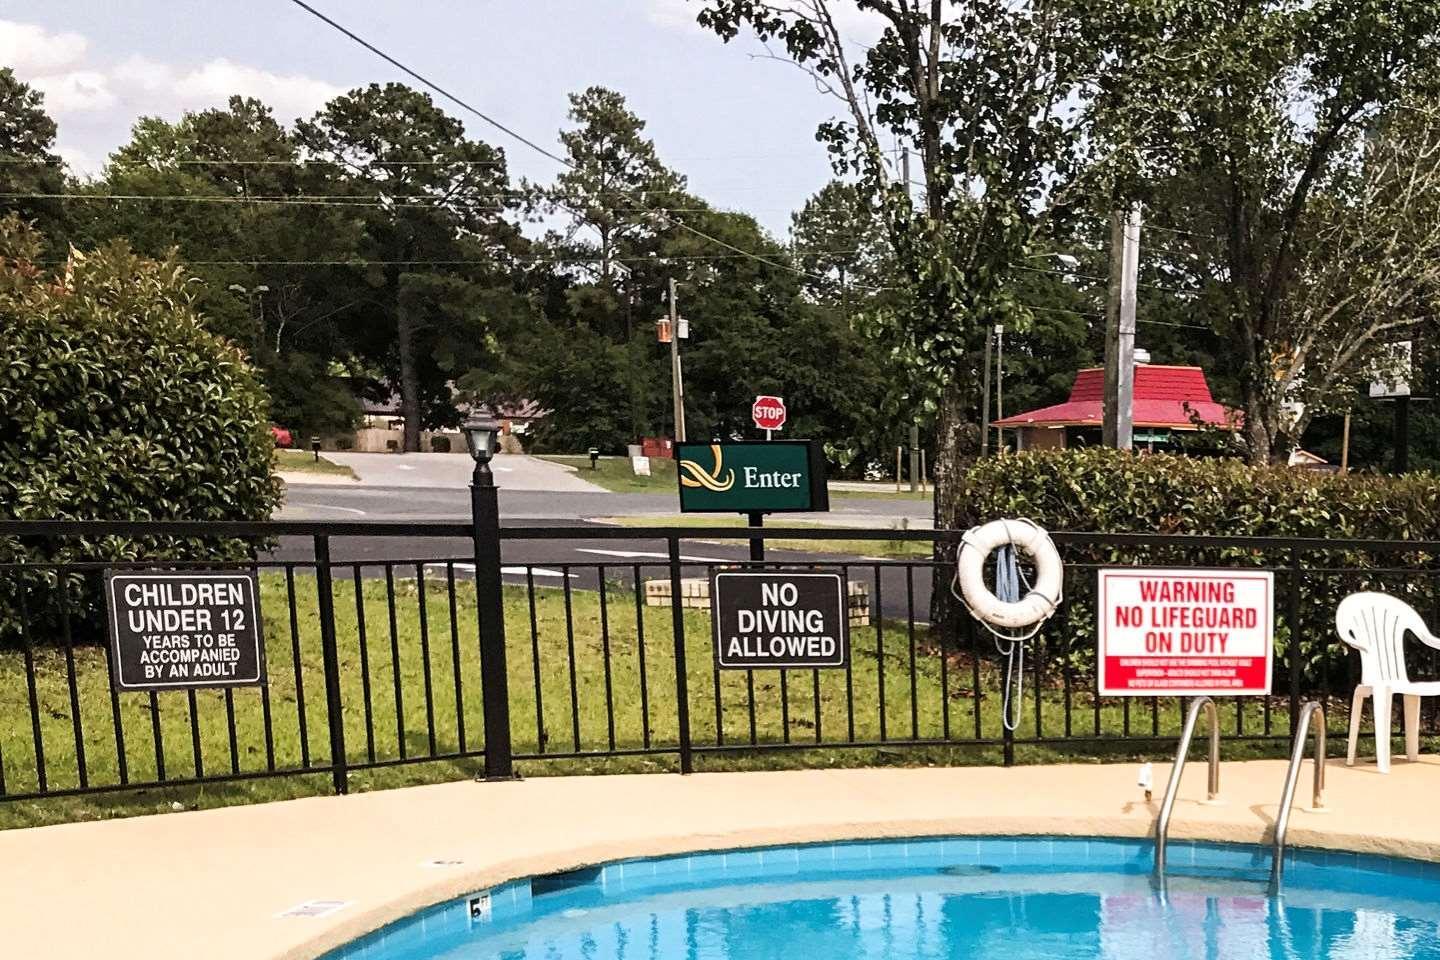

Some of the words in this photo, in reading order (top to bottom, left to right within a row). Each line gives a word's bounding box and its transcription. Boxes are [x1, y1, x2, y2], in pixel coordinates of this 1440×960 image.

[755, 406, 784, 420] STOP
[743, 466, 802, 488] Enter
[124, 583, 244, 607] CHILDREN
[761, 582, 798, 607] NO
[1139, 580, 1235, 604] WARNING
[128, 609, 212, 633] UNDER
[221, 608, 246, 631] 12
[737, 609, 824, 634] DIVING
[1115, 606, 1144, 628] NO
[1151, 606, 1258, 629] LIFEGUARD
[142, 635, 190, 649] YEARS
[194, 634, 214, 648] TO
[218, 633, 236, 647] BE
[727, 636, 836, 658] ALLOWED
[1145, 631, 1172, 653] ON
[1180, 632, 1230, 654] DUTY
[140, 648, 240, 664] ACCOMPANIED
[145, 665, 163, 679] BY
[169, 664, 189, 678] AN
[194, 662, 238, 677] ADULT
